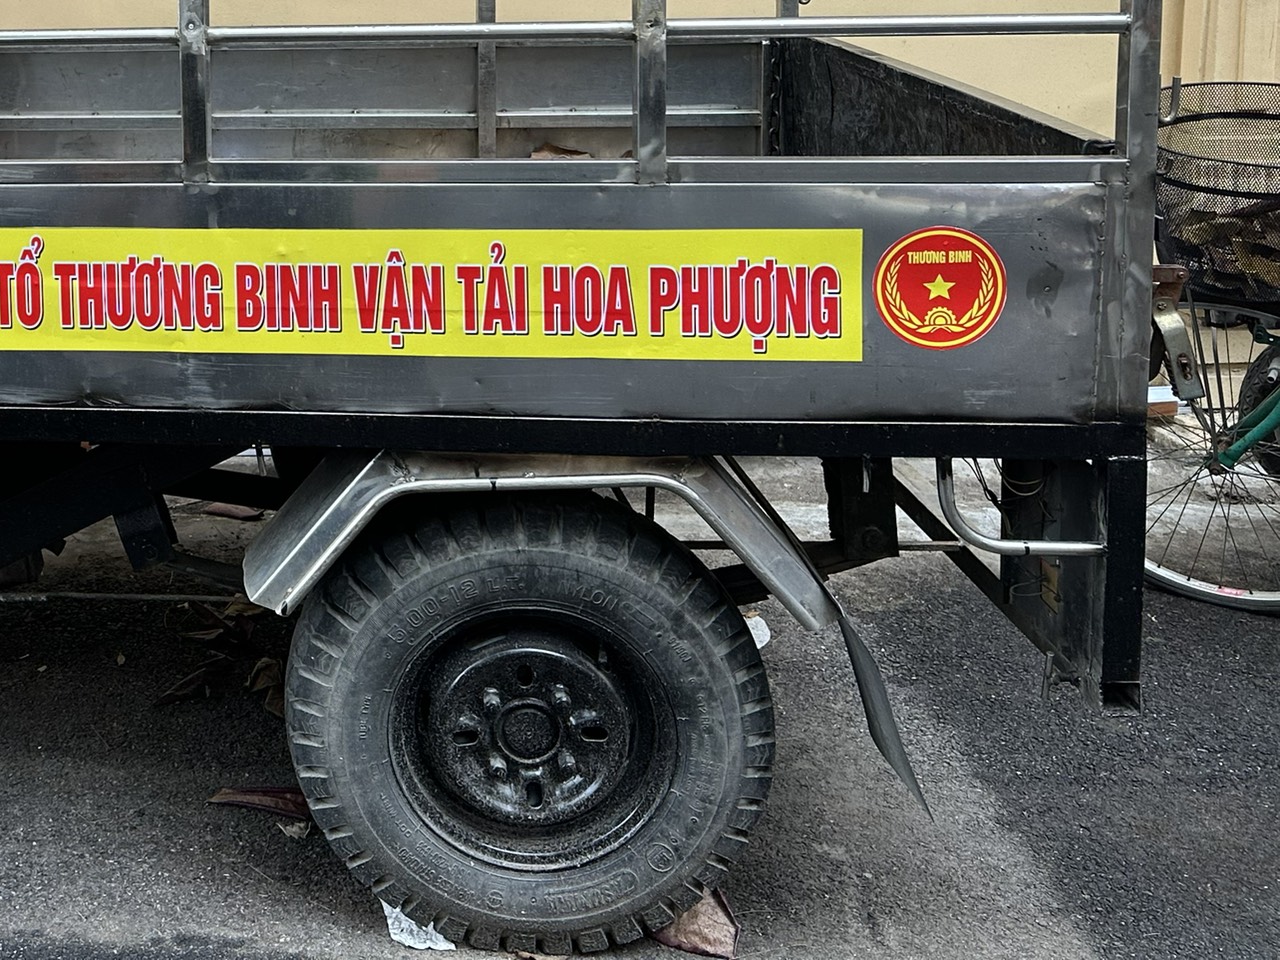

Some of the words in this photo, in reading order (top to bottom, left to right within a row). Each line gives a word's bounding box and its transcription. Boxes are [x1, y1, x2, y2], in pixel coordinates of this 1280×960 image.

[907, 250, 946, 264] THƯƠNG
[948, 250, 972, 263] BINH
[54, 254, 224, 332] THƯƠNG
[236, 262, 343, 333] BINH
[354, 249, 444, 348] VẬN
[456, 242, 531, 336] TẢI
[542, 264, 637, 337] HOA
[648, 257, 843, 353] PHƯỢNG
